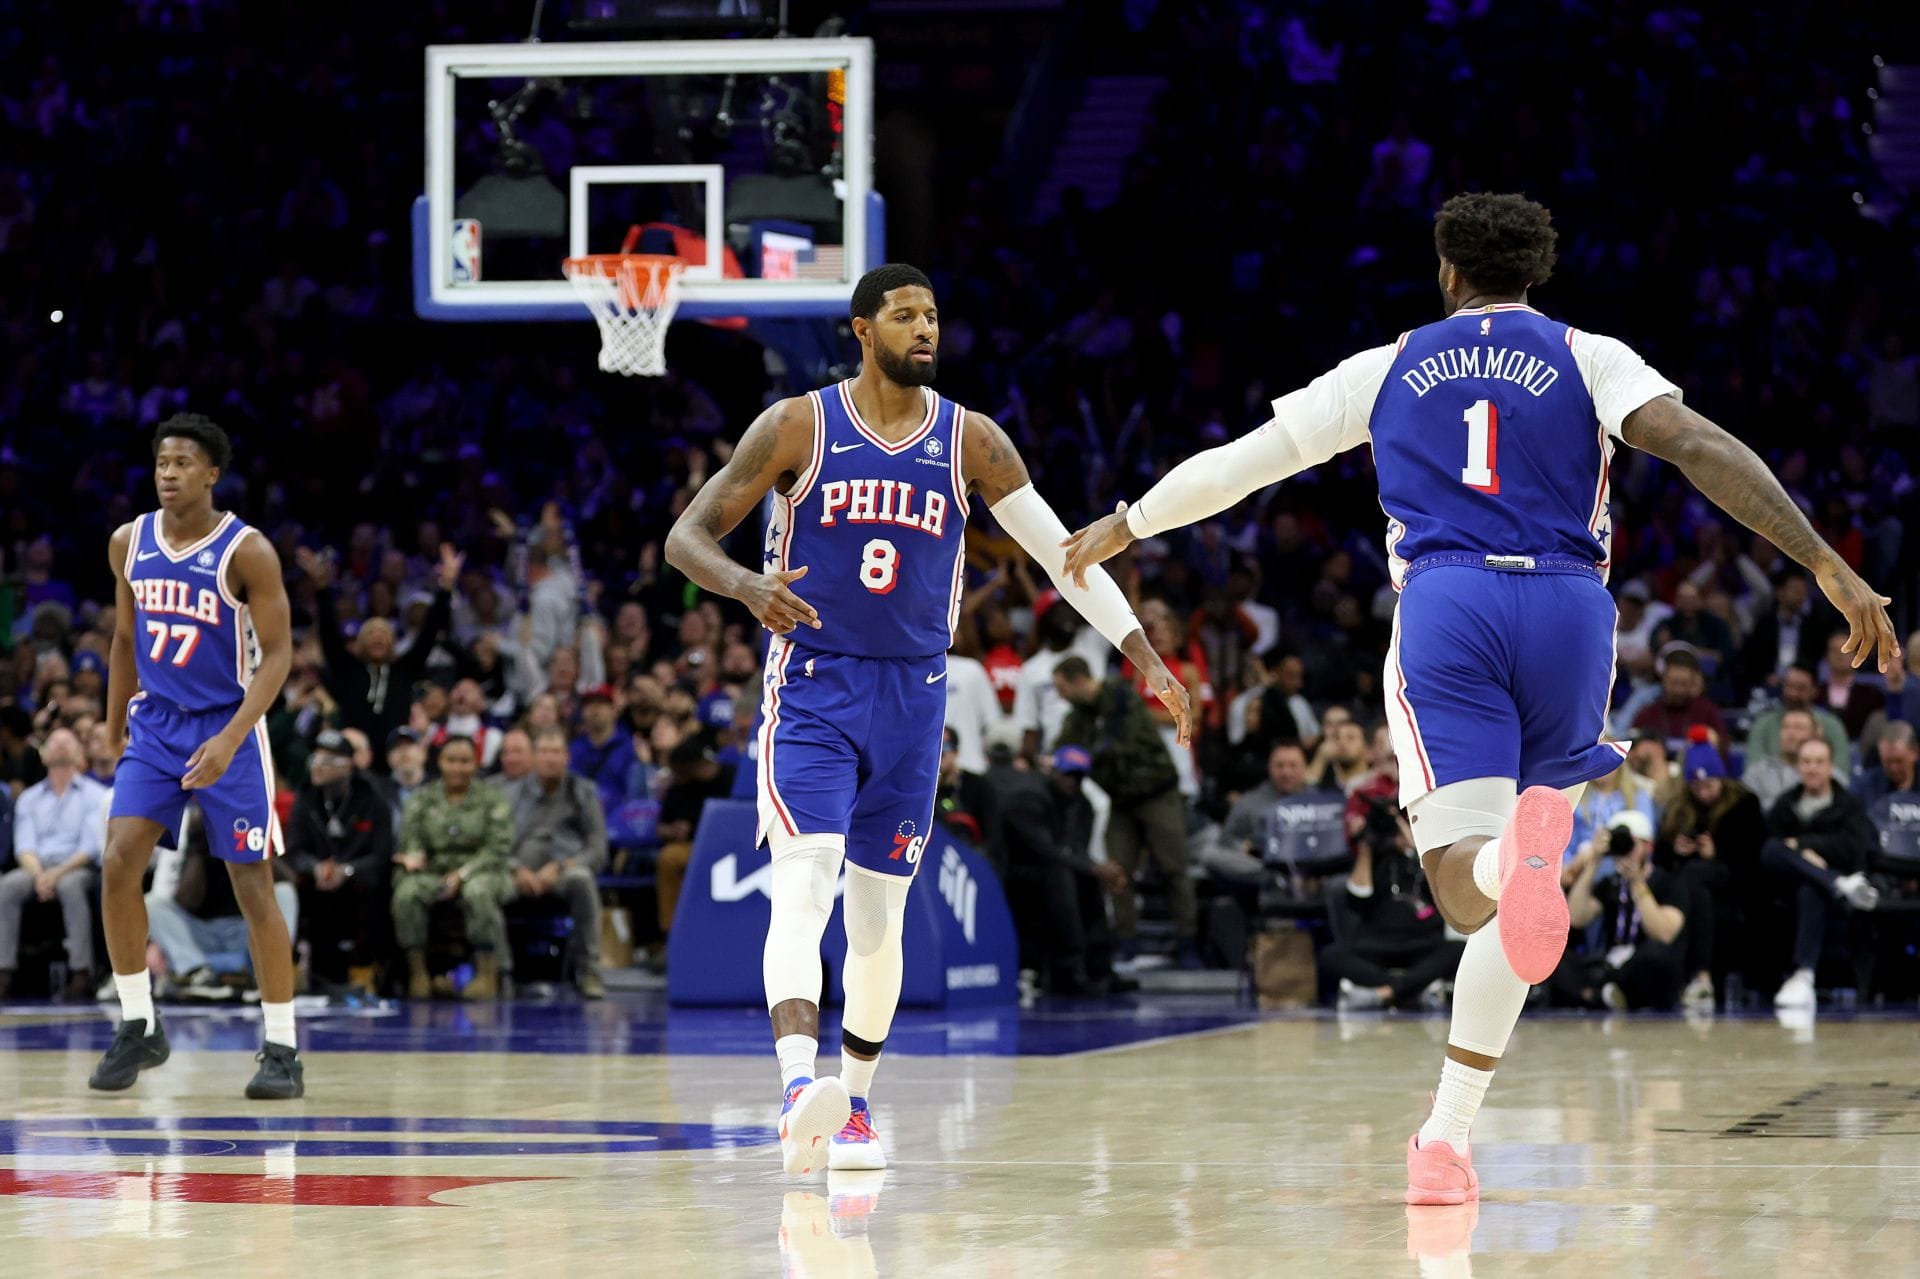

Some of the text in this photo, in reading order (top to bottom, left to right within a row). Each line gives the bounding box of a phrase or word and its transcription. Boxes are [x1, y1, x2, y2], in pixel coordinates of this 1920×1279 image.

[1402, 346, 1559, 397] DRUMMOND
[915, 457, 950, 468] crypto.com
[1462, 400, 1500, 495] 1
[820, 479, 948, 539] PHILA
[859, 538, 900, 595] 8
[130, 578, 221, 626] PHILA
[146, 620, 201, 668] 77
[233, 827, 265, 853] 76
[888, 832, 923, 864] 76
